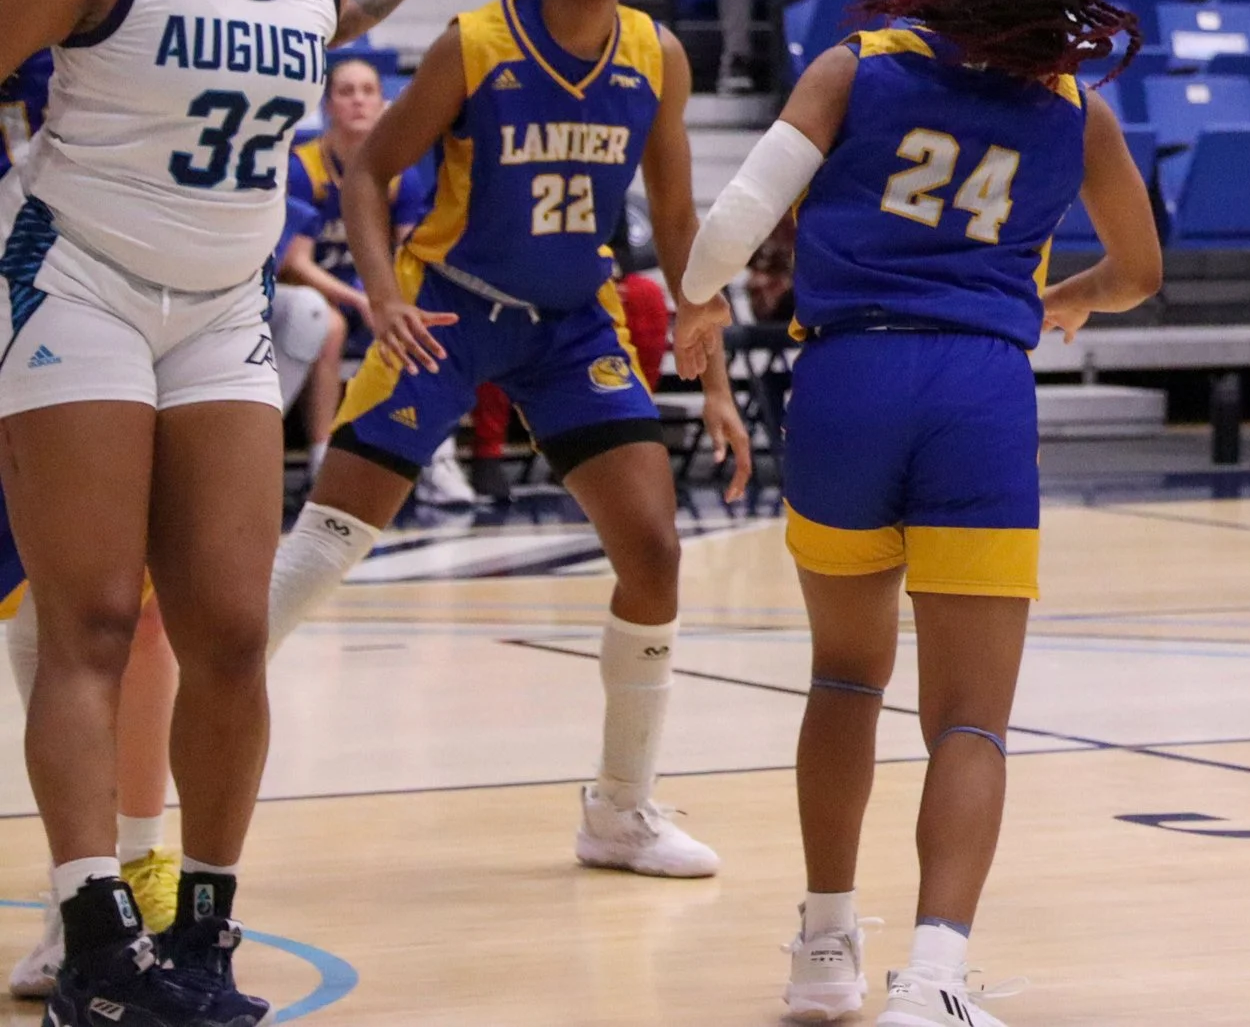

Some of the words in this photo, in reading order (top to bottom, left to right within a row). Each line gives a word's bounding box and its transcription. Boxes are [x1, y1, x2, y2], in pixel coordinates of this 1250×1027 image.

[168, 89, 306, 191] 32
[880, 128, 1020, 245] 24
[531, 174, 597, 236] 22
